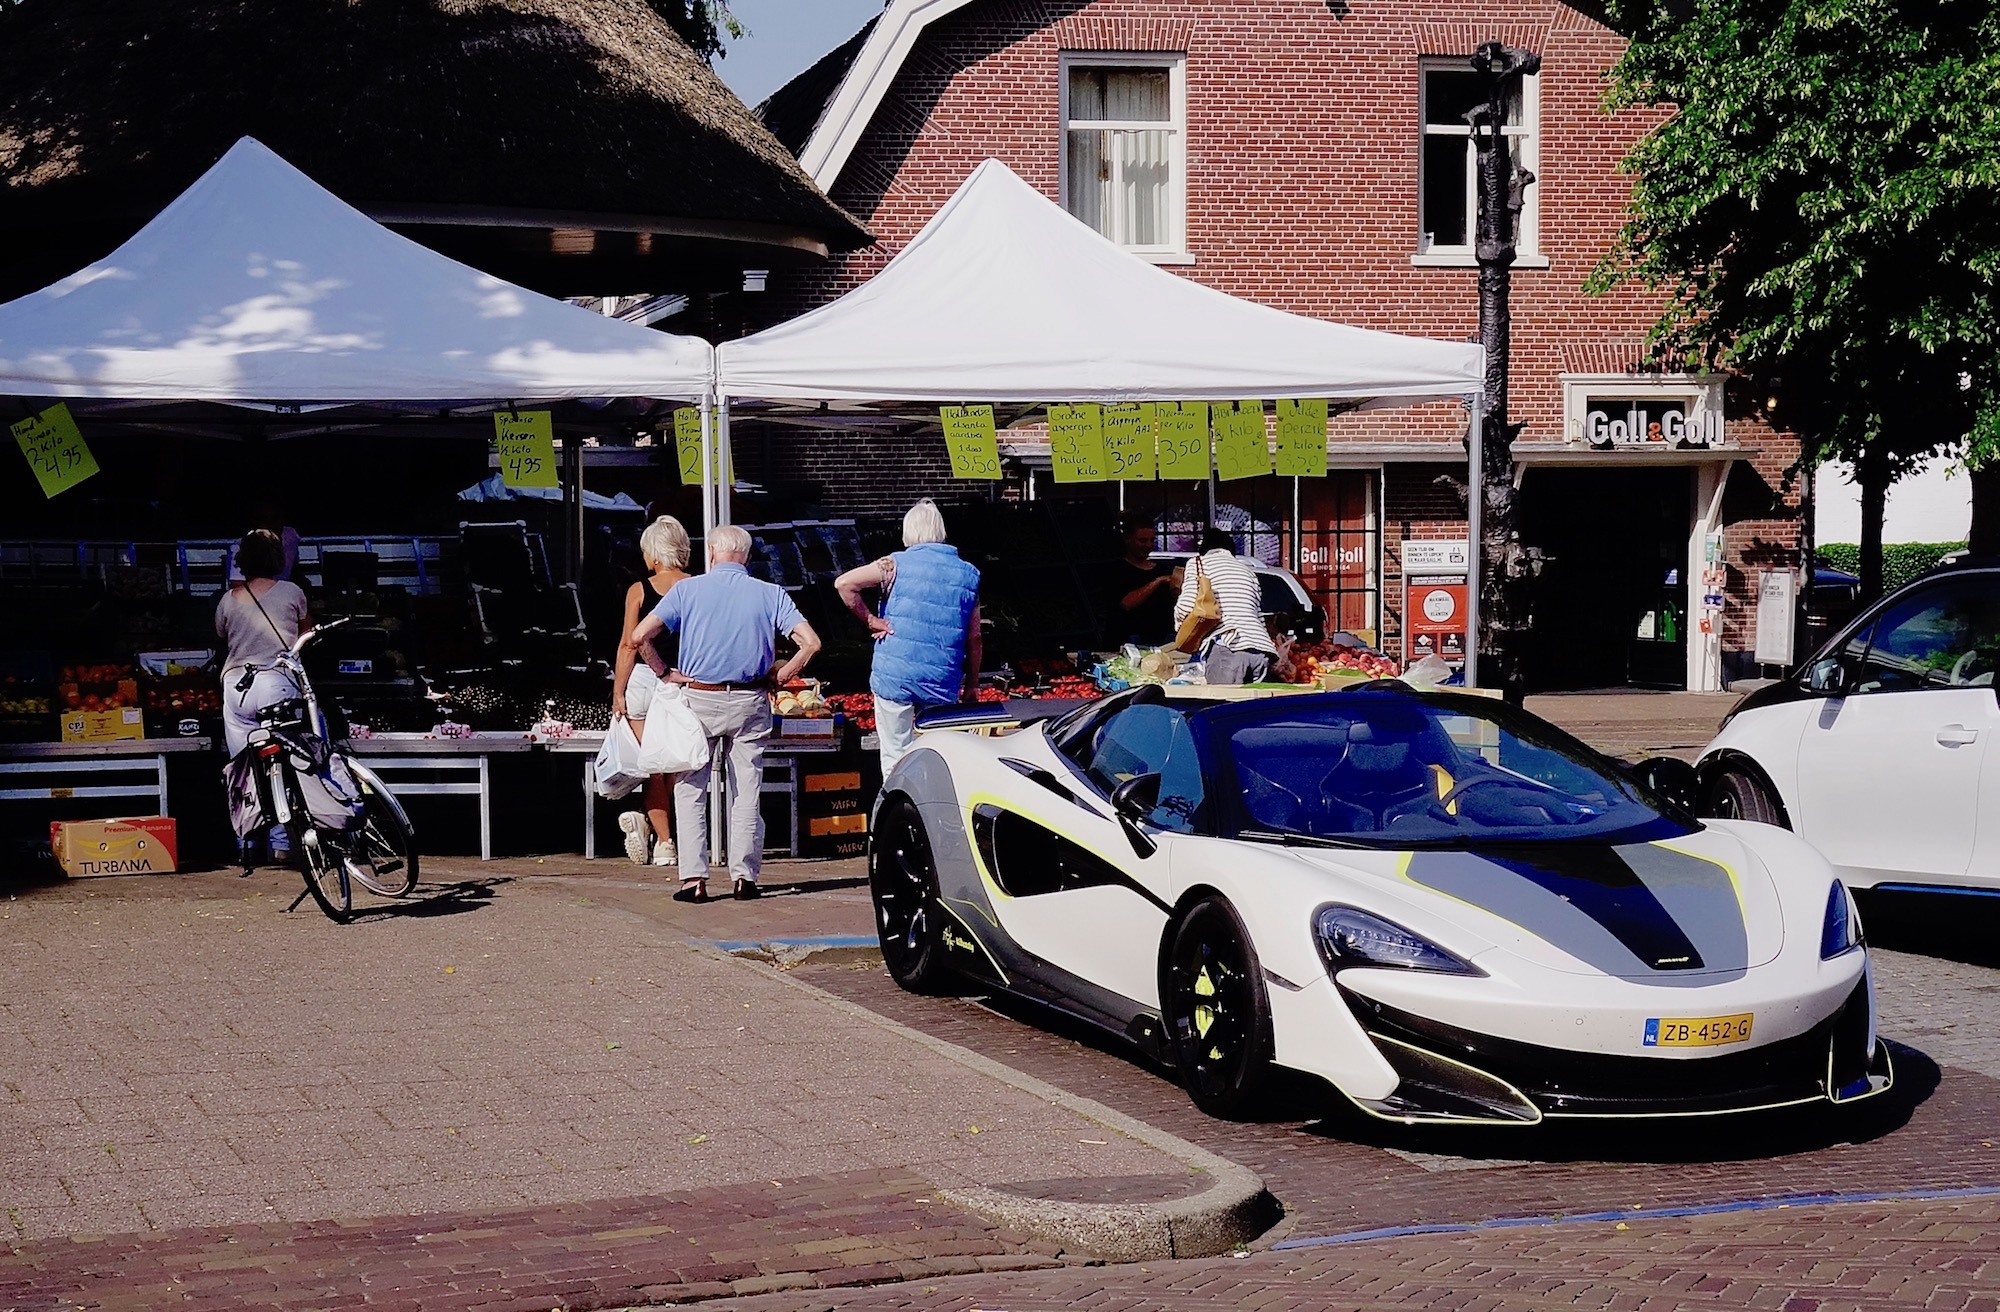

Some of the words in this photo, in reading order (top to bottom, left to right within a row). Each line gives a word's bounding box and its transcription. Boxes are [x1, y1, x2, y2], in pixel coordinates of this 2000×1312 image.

[1050, 408, 1086, 421] Groene
[957, 454, 997, 474] 3,50
[1301, 546, 1328, 564] Gall
[1335, 546, 1364, 563] Gall
[104, 826, 138, 834] Premium
[141, 824, 172, 832] Bananas
[79, 858, 152, 875] TURBANA
[1645, 1034, 1657, 1043] NL
[1664, 1019, 1748, 1042] ZB-452-G
